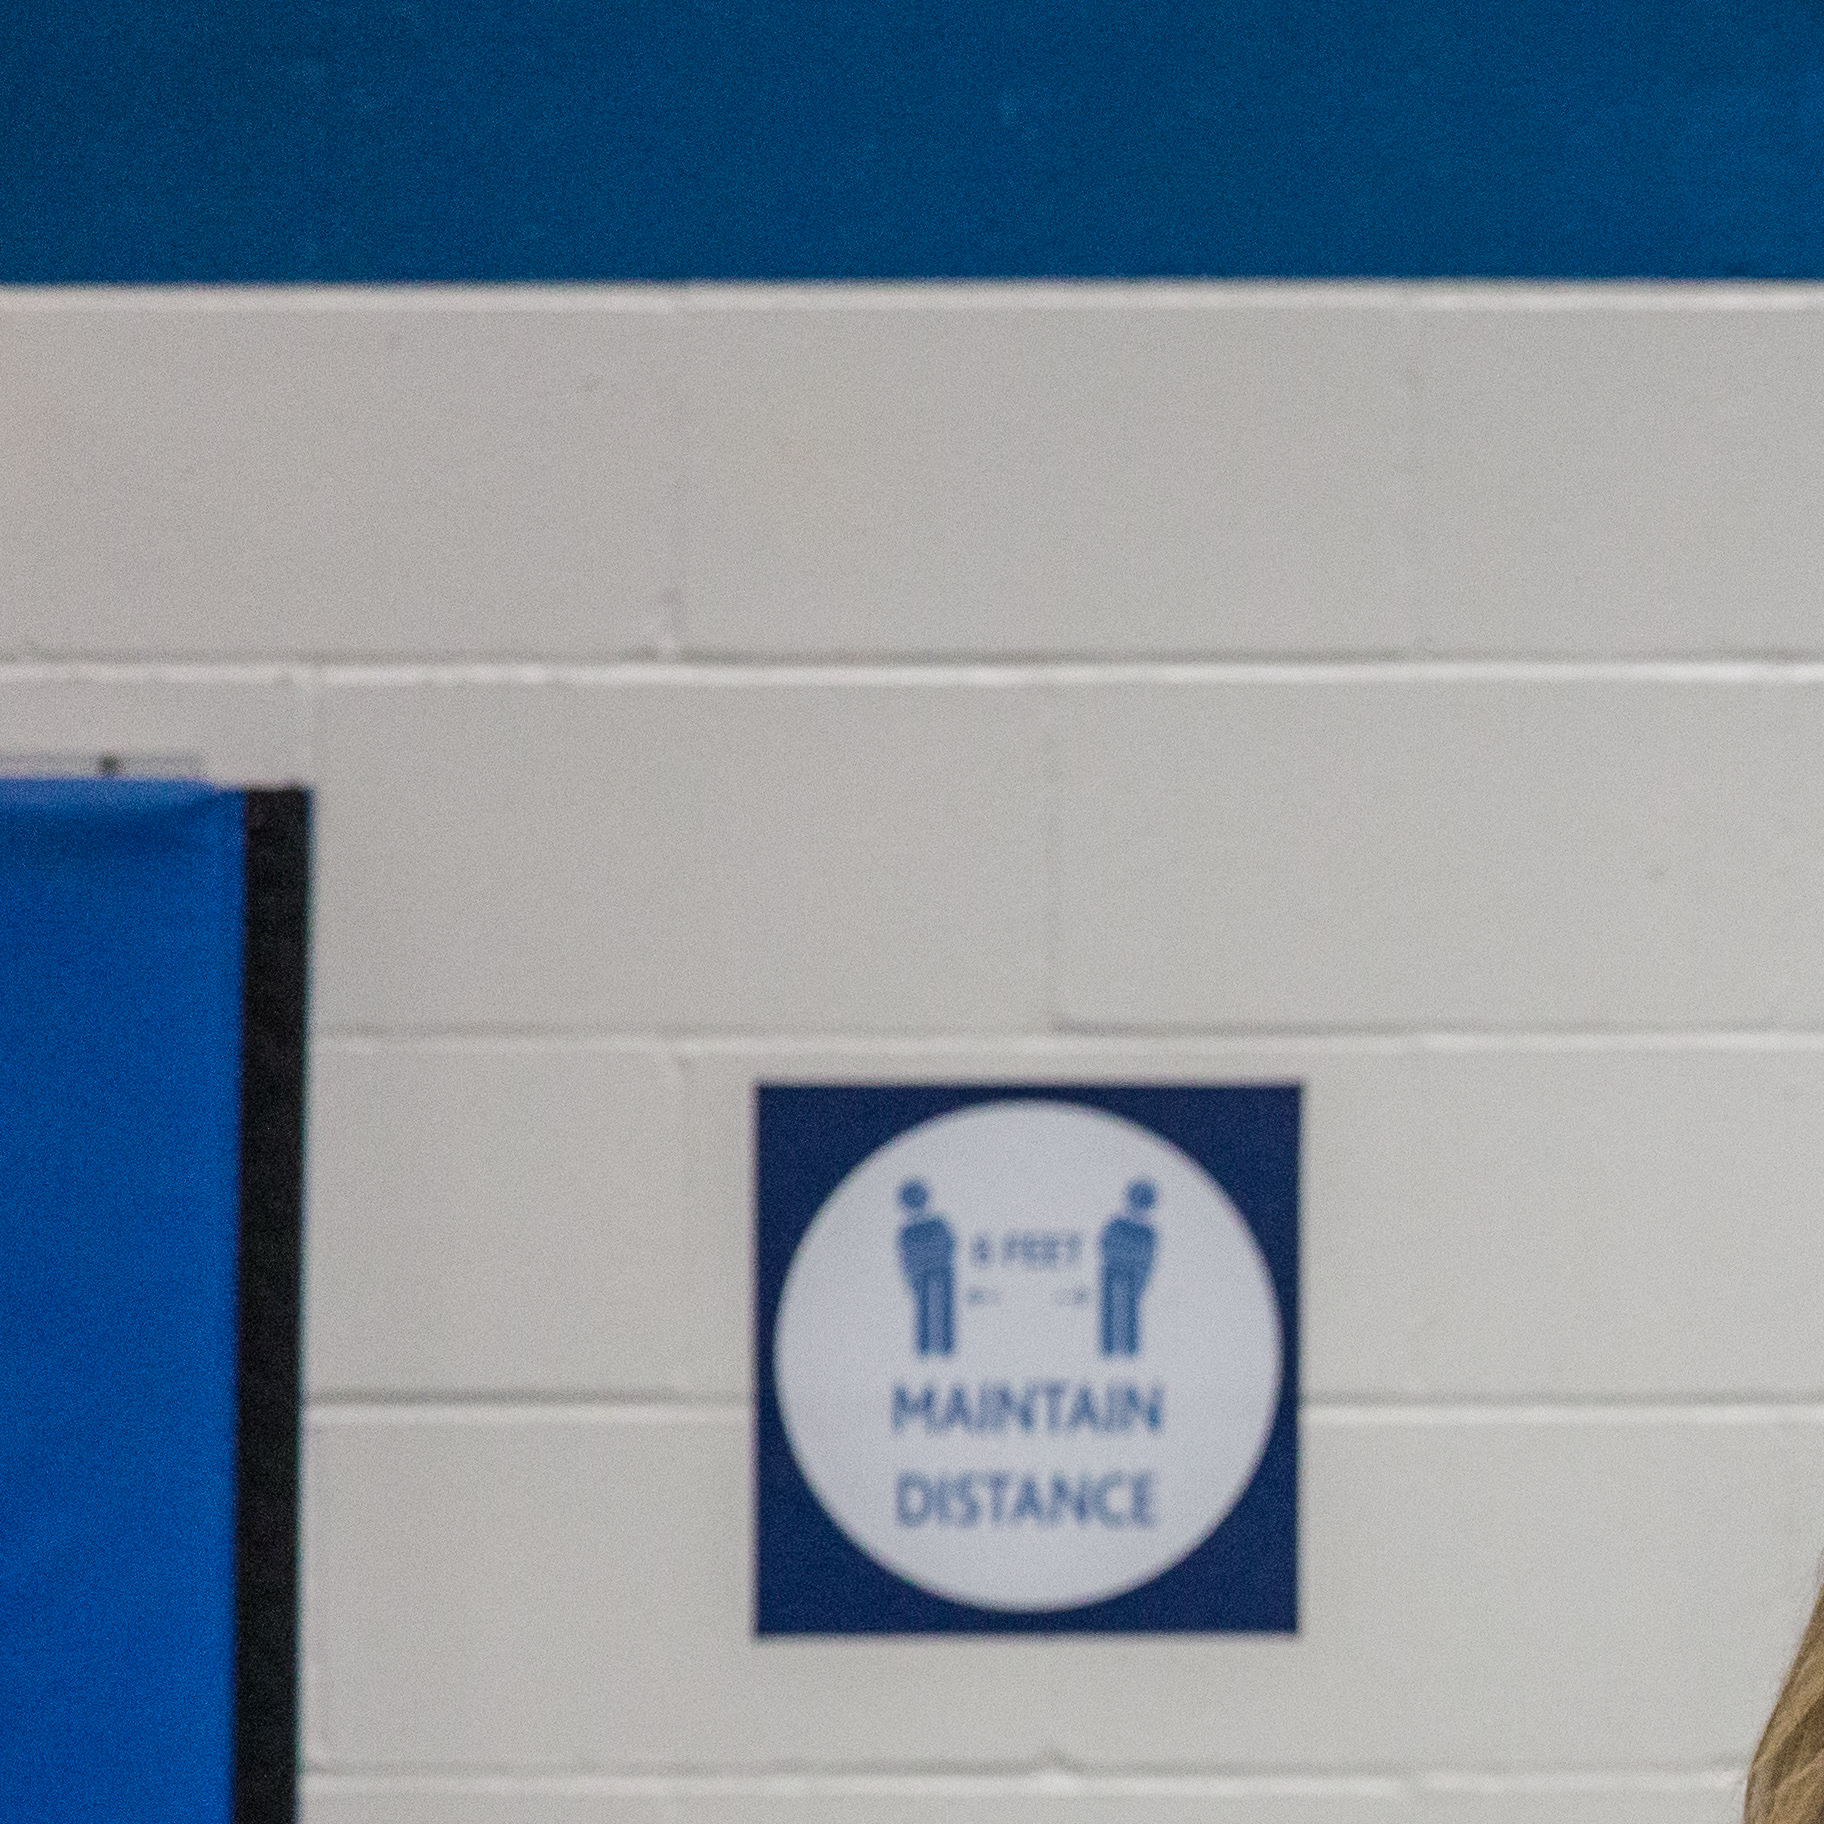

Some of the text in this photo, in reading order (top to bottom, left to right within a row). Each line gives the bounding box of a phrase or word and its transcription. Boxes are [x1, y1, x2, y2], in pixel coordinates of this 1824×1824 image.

[1002, 1231, 1082, 1268] FEET
[891, 1381, 1163, 1433] MAINTAIN
[895, 1471, 1155, 1528] DISTANCE
